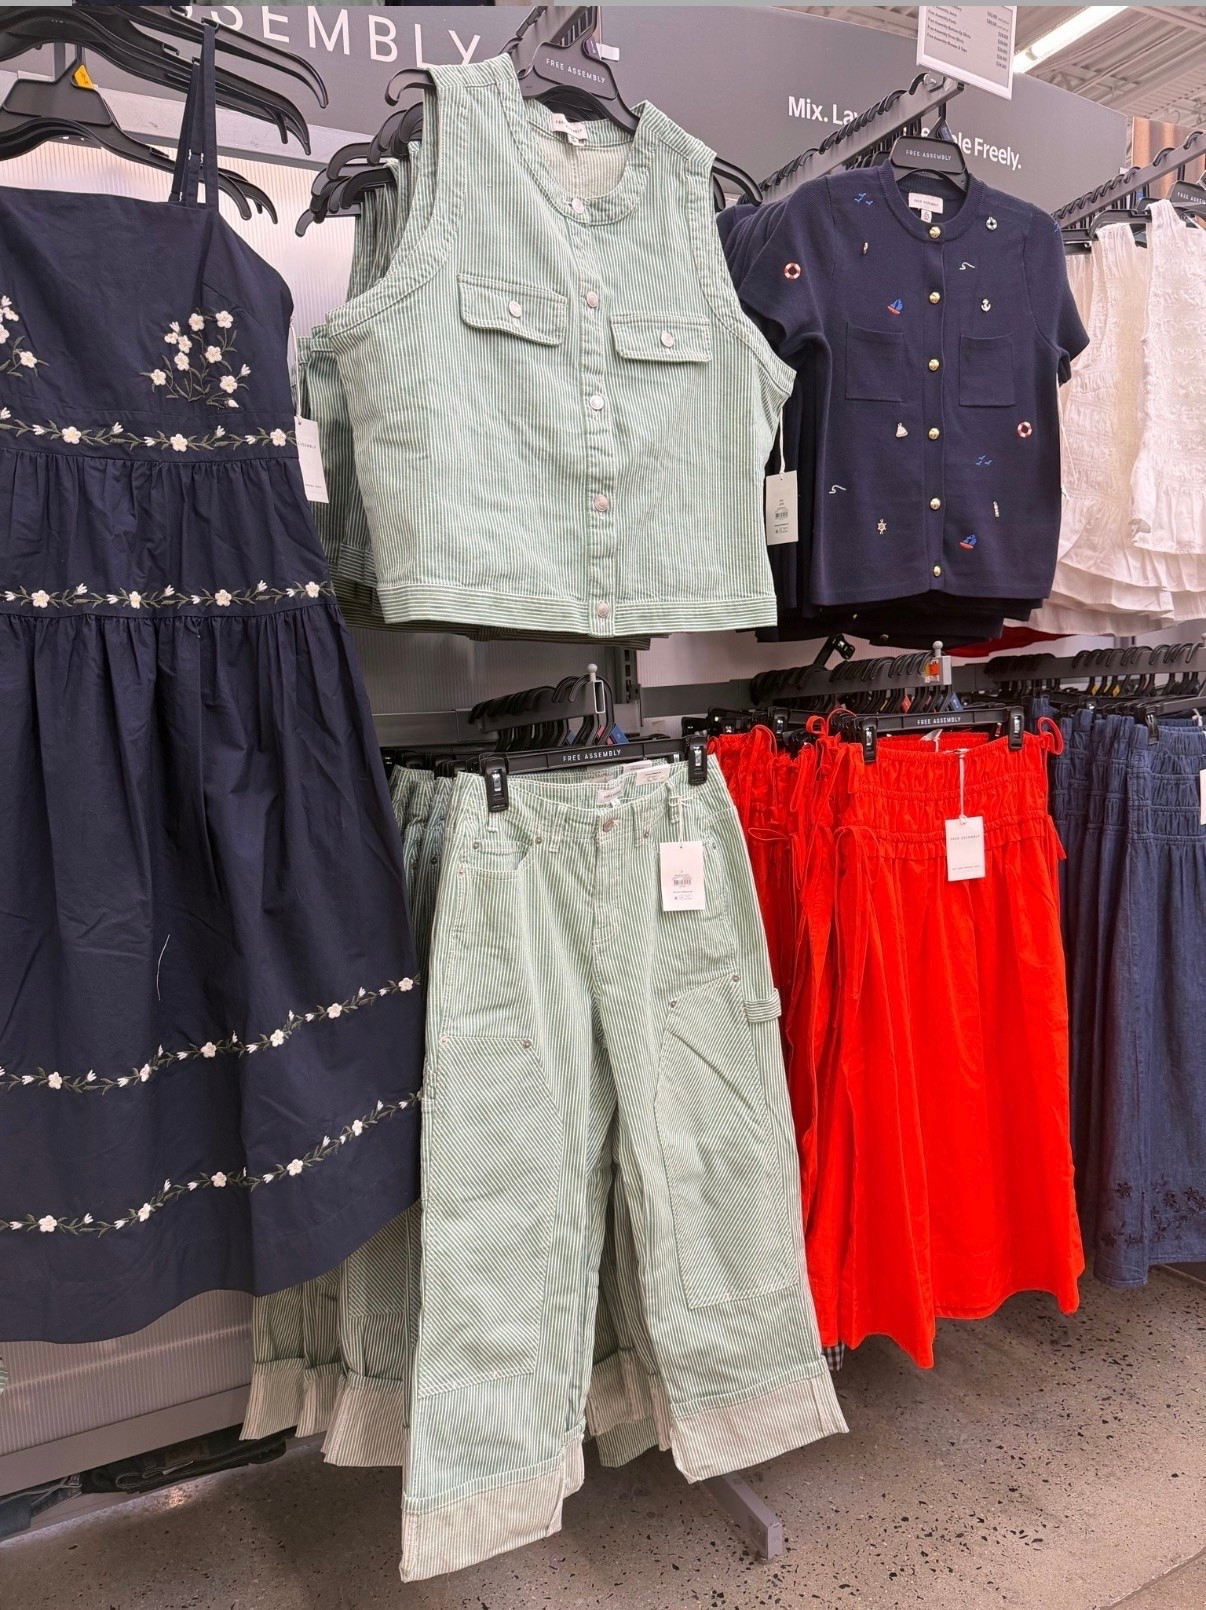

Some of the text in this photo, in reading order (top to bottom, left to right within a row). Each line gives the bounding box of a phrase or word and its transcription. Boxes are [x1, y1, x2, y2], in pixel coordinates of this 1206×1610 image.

[546, 58, 606, 84] FREE ASSEMBLY
[788, 95, 829, 123] Mix.
[905, 149, 952, 161] FREE ASSEMBLY
[974, 137, 1022, 171] Freely.
[933, 716, 961, 724] ASSEMBLY
[563, 749, 621, 762] FREE ASSEMBLY
